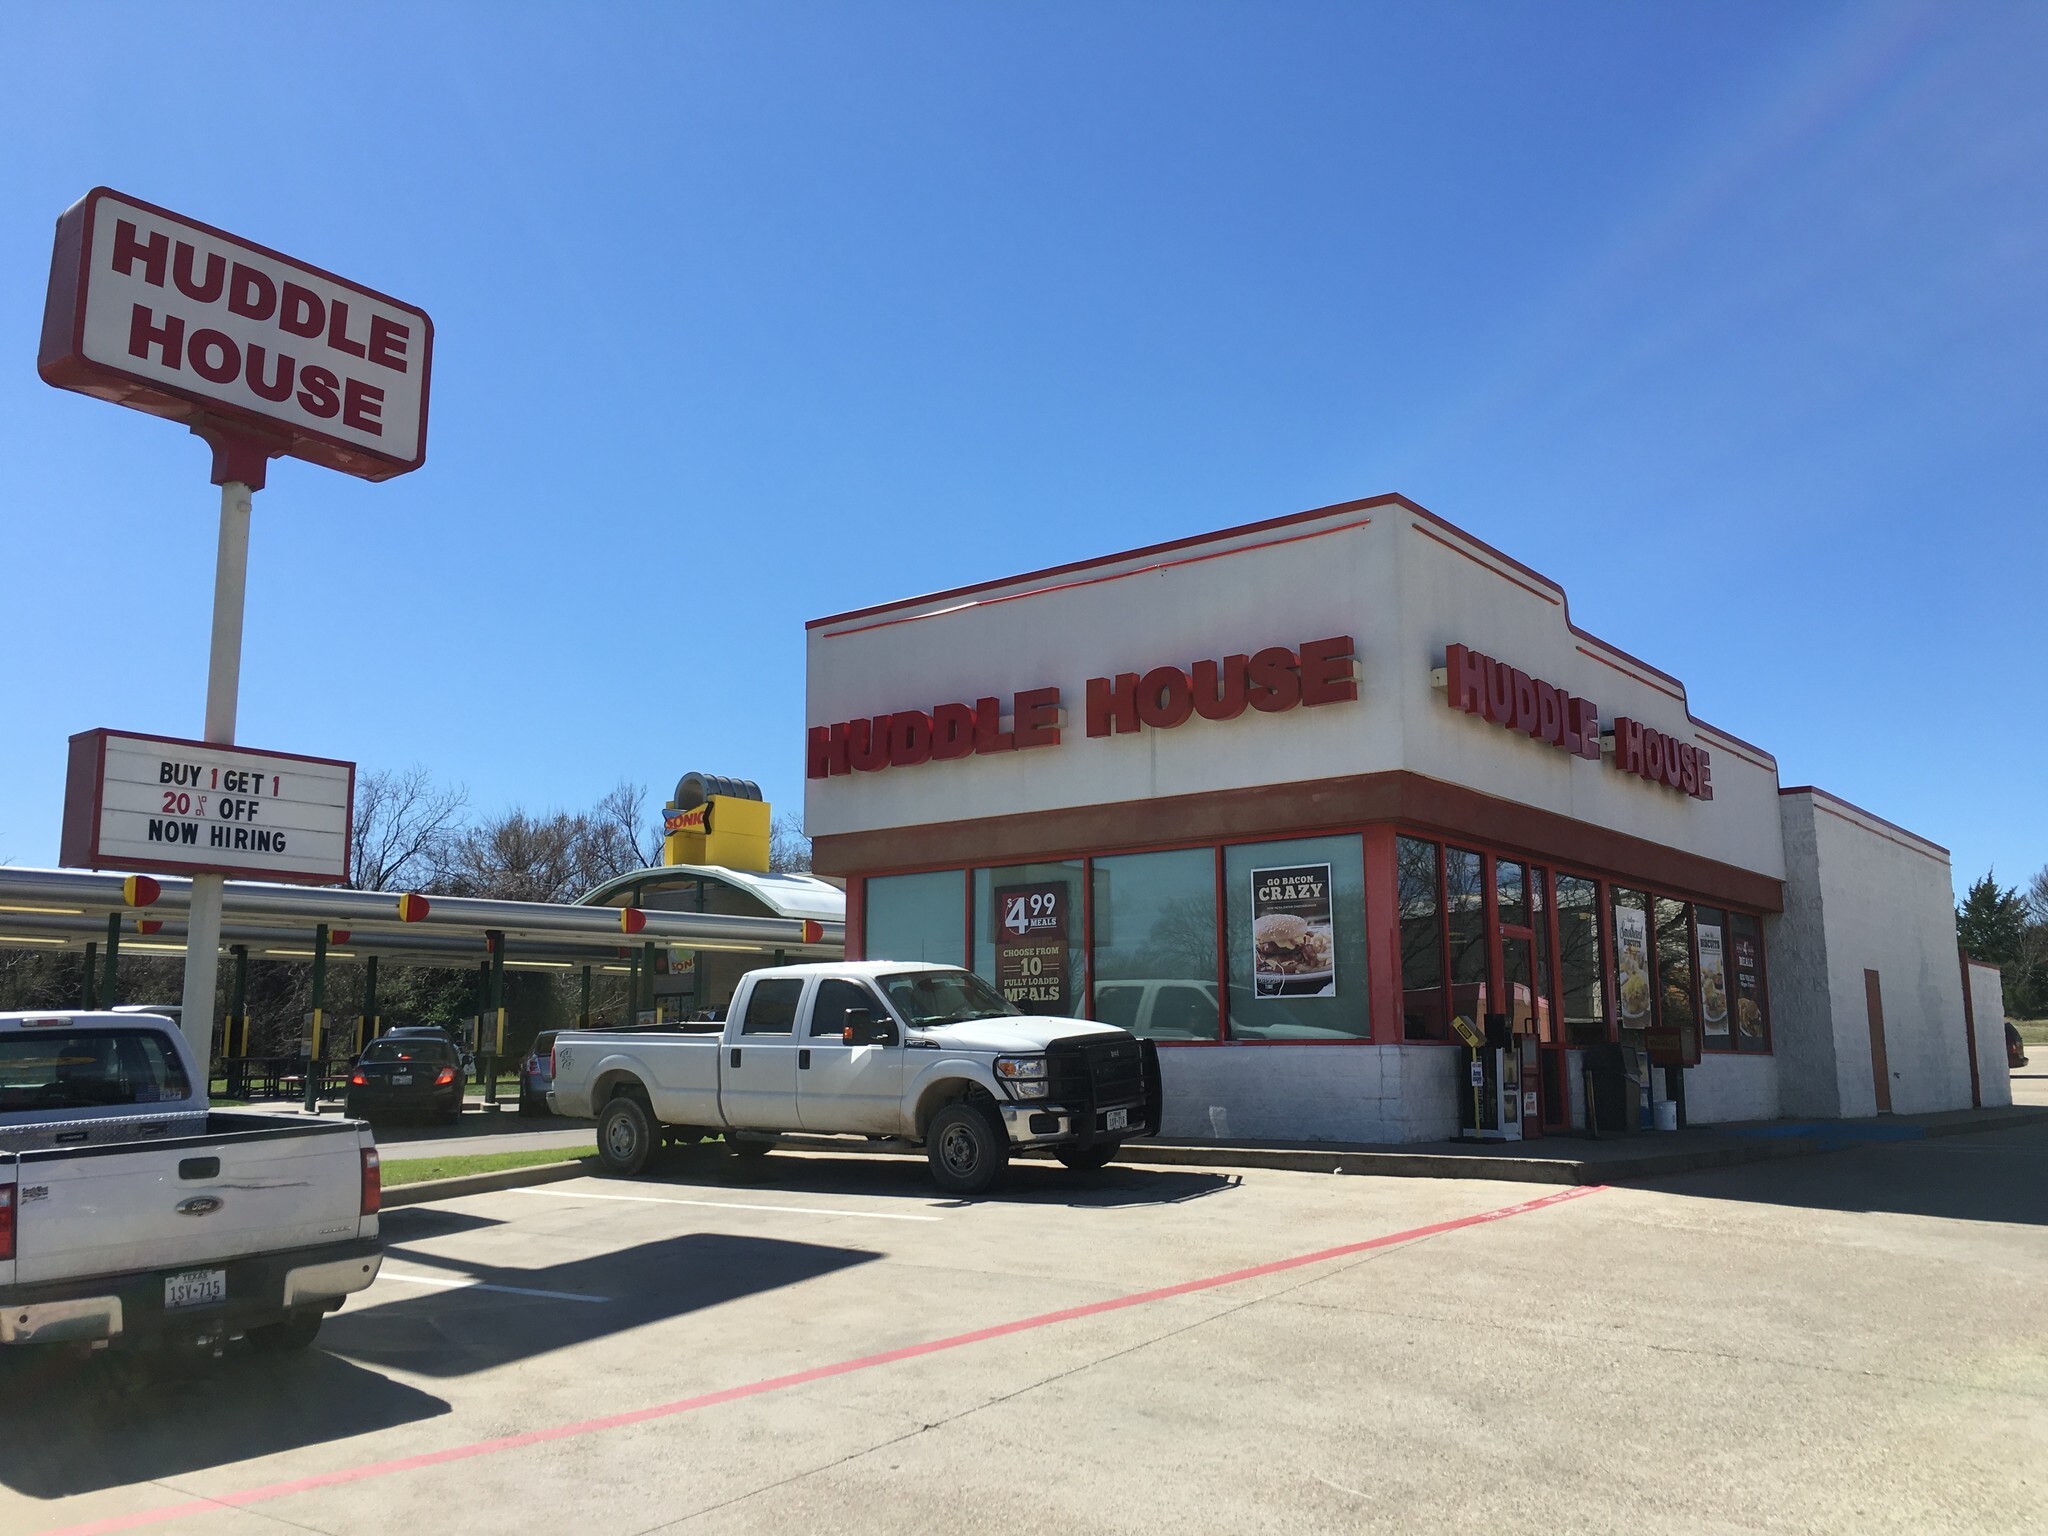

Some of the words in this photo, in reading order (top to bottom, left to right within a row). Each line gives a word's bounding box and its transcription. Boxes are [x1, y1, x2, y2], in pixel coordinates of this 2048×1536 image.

[112, 218, 410, 373] HUDDLE
[128, 303, 385, 437] HOUSE
[807, 686, 1061, 779] HUDDLE
[1086, 635, 1359, 738] HOUSE
[1446, 642, 1600, 760] HUDDLE
[1614, 717, 1713, 801] HOUSE
[159, 762, 202, 786] BUY
[210, 768, 218, 790] 1
[223, 770, 265, 795] GET
[272, 776, 280, 797] 1
[219, 798, 259, 822] OFF
[666, 811, 705, 830] SONIC
[148, 819, 199, 845] NOW
[210, 825, 287, 853] HIRING
[1267, 878, 1280, 886] GO
[1282, 875, 1314, 885] BACON
[1258, 883, 1323, 902] CRAZY
[1030, 918, 1057, 927] MEALS
[1003, 948, 1035, 957] CHOOSE
[1036, 946, 1059, 956] FROM
[1020, 957, 1042, 976] 10
[1004, 978, 1027, 987] FULLY
[1028, 977, 1059, 985] LOADED
[1004, 987, 1060, 1002] MEALS
